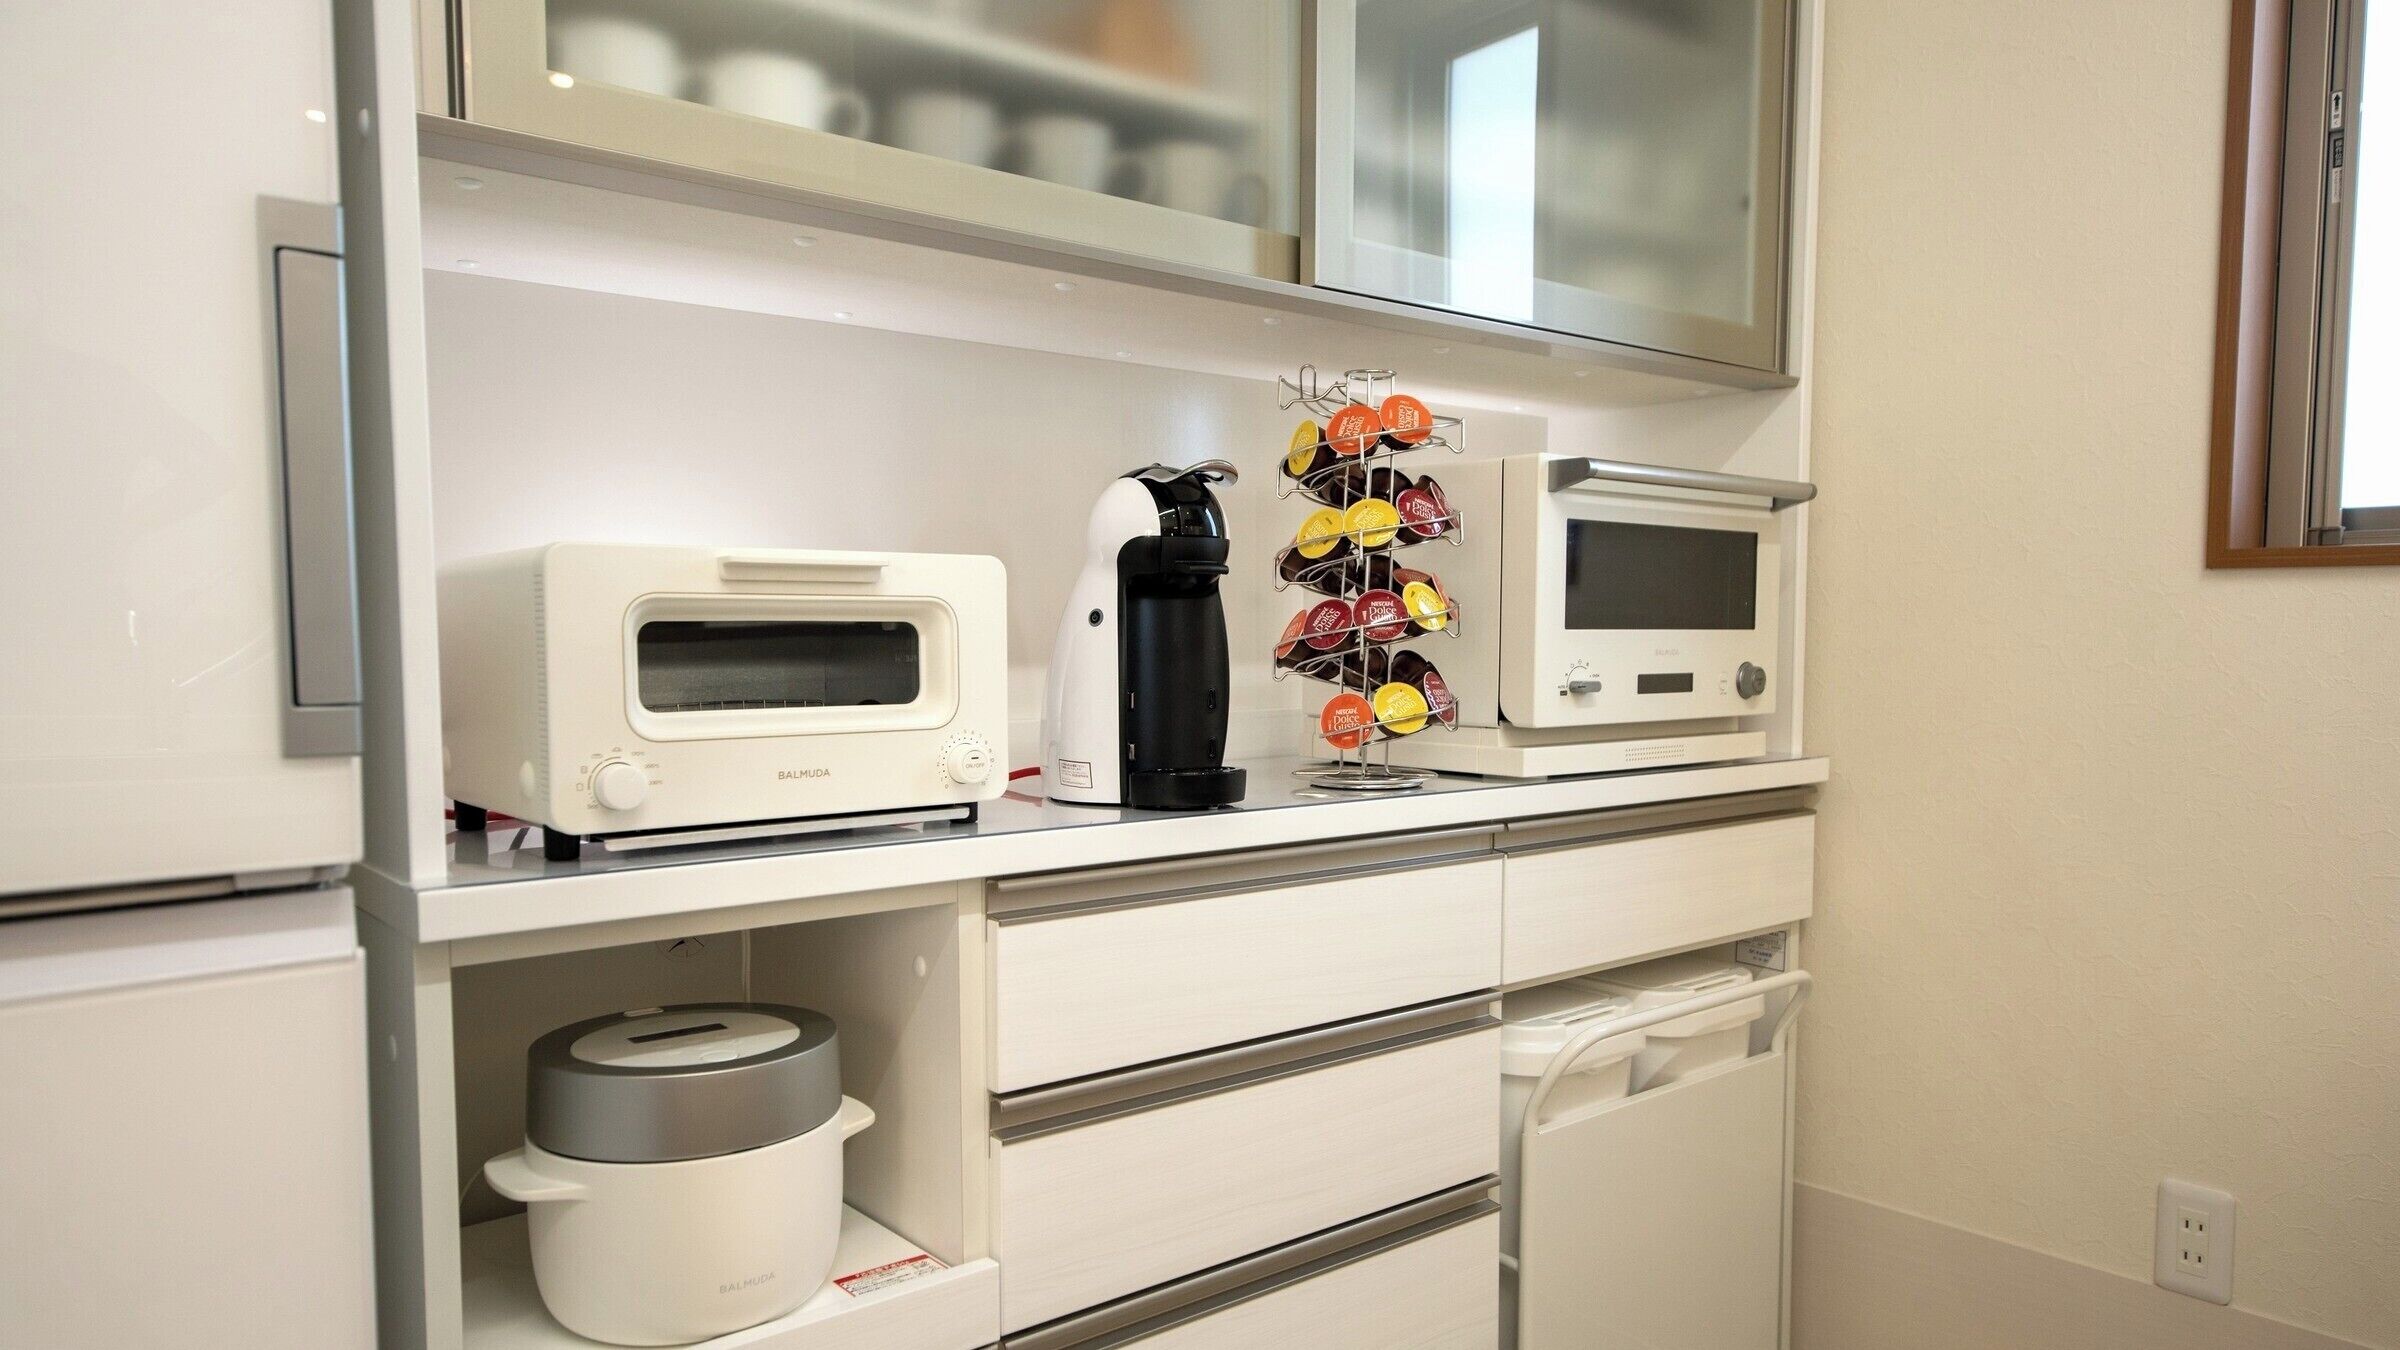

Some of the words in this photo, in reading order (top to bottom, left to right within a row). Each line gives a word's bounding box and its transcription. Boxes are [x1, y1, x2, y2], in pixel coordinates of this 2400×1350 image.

[1369, 606, 1397, 615] Dolce
[1333, 714, 1360, 724] Dolce
[777, 768, 832, 780] BALMUDA
[718, 1271, 776, 1295] BALMUDA
